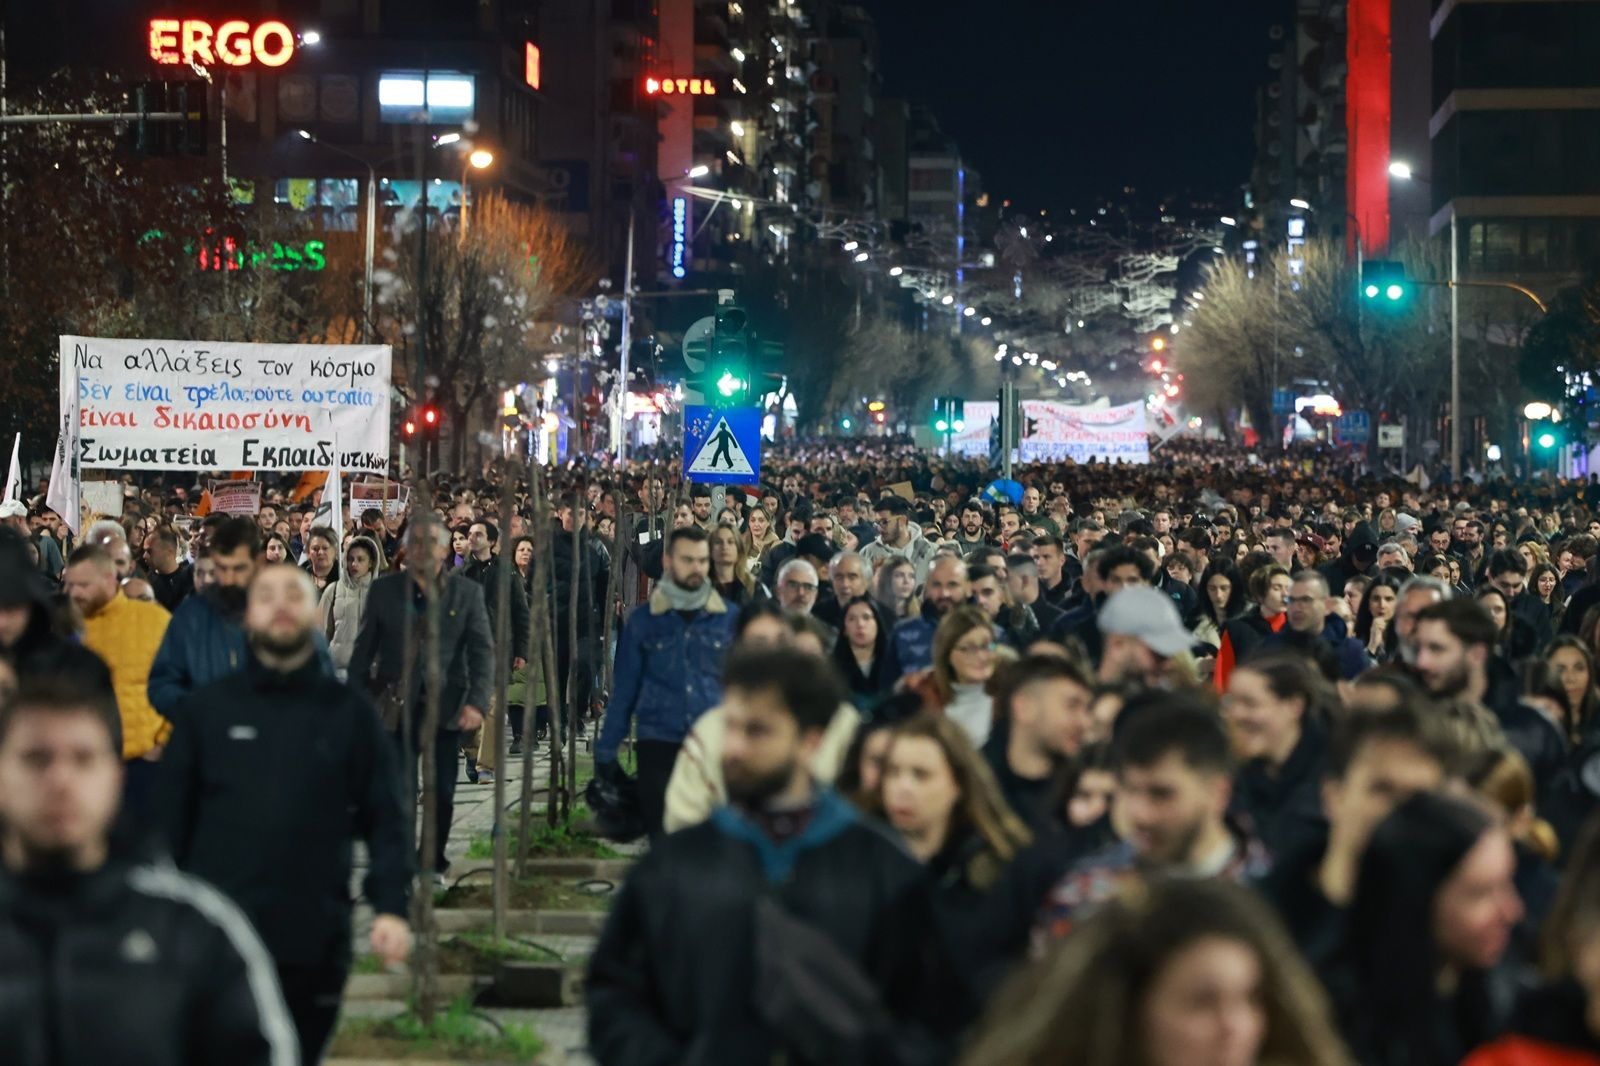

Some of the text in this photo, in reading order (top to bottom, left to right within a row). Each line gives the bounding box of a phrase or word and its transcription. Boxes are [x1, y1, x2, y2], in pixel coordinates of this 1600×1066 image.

[150, 19, 294, 67] ERGO
[74, 343, 376, 388] Να αλλάξεις τον κόσμο
[124, 380, 173, 402] είναι
[302, 387, 373, 407] ουτοπία
[153, 404, 313, 433] δικαιοσύνη
[79, 438, 218, 467] Σωματεία
